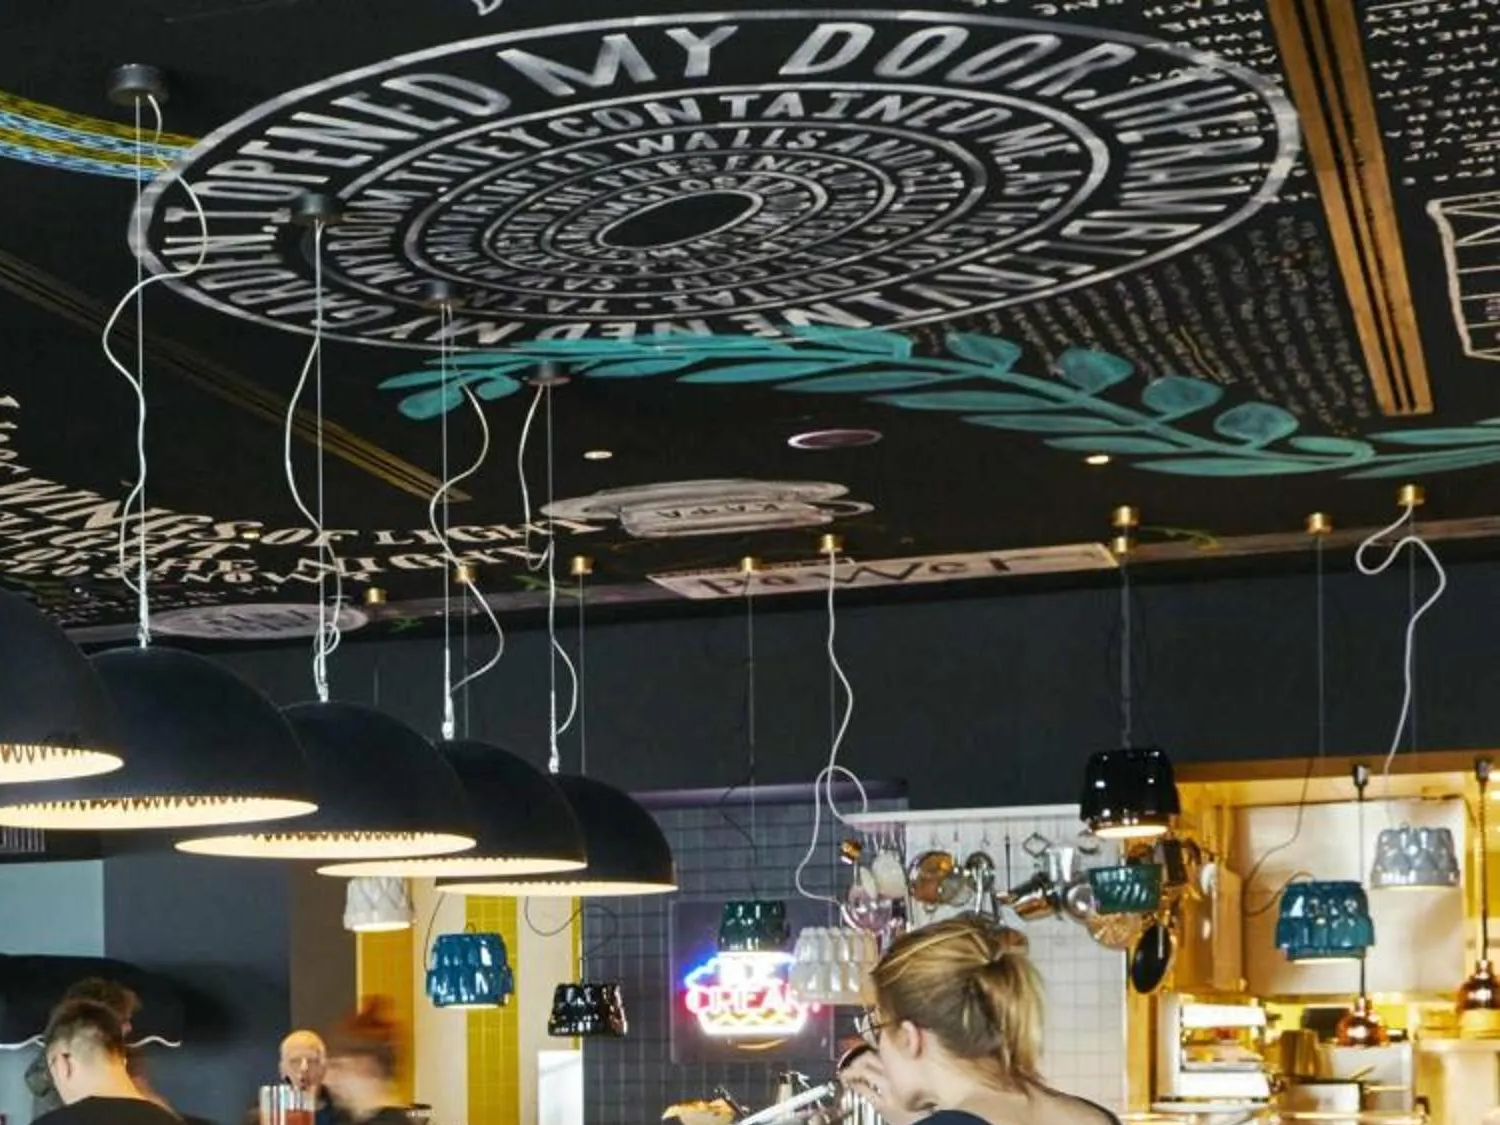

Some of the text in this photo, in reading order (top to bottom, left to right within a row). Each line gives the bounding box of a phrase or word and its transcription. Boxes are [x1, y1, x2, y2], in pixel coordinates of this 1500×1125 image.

[499, 24, 738, 97] MY
[776, 22, 1137, 101] DOOR.
[546, 90, 1012, 139] CONTAINED
[1072, 67, 1260, 145] THE
[183, 68, 511, 201] OPENED
[386, 127, 550, 184] THEY
[614, 127, 829, 158] WALLS
[820, 132, 936, 167] AND
[436, 151, 612, 221] PAINTED
[593, 155, 848, 188] PRESENCE
[860, 162, 964, 234] CEILING
[1001, 170, 1083, 196] AS
[327, 180, 451, 251] ROOM.
[943, 197, 1062, 235] THE
[958, 136, 1265, 287] RAMBLER
[161, 226, 399, 329] GARDEN.
[332, 254, 422, 285] MY
[877, 233, 986, 270] SKY
[374, 313, 528, 346] MY
[260, 528, 359, 548] OF
[375, 519, 606, 545] LIGHT
